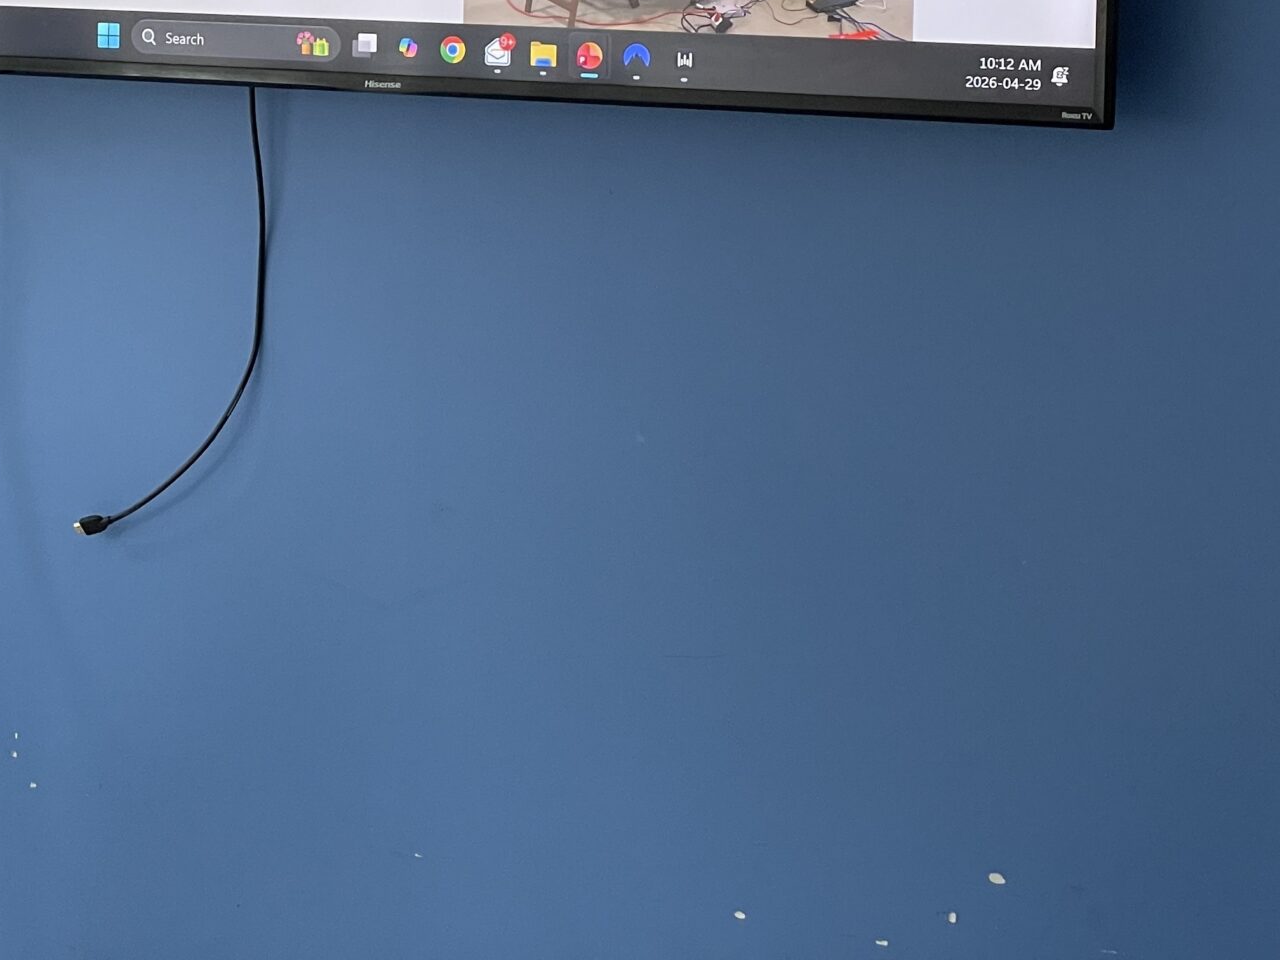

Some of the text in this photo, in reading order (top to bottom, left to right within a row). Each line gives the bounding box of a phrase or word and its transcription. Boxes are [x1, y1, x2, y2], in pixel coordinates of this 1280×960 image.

[165, 32, 205, 46] Search
[980, 57, 1041, 71] 10:12 AM
[365, 80, 401, 89] Hisense
[965, 76, 1041, 90] 2026-04-29
[1082, 112, 1093, 120] TV
